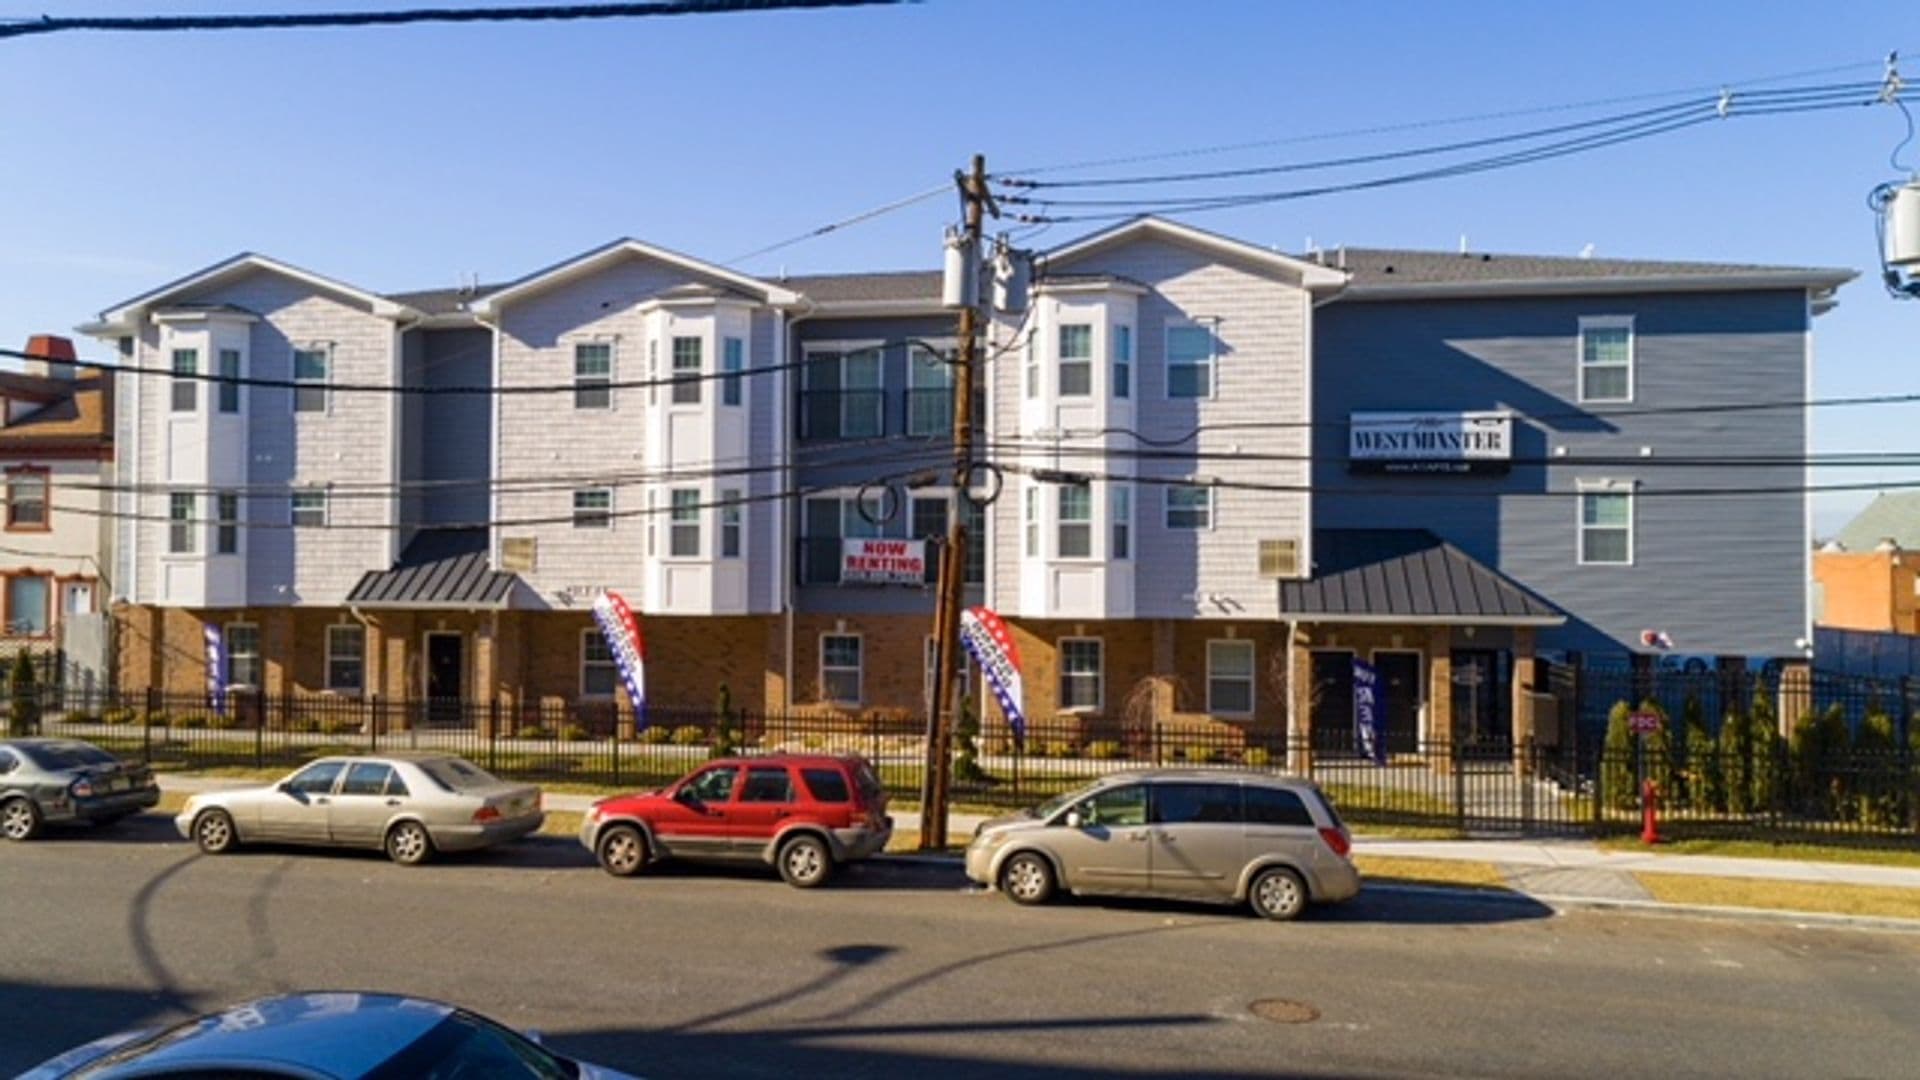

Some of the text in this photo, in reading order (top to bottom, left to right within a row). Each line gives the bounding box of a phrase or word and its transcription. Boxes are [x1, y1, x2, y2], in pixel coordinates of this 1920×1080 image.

[1354, 431, 1502, 450] WESTMINSTER
[863, 541, 907, 555] NOW
[846, 556, 922, 573] RENTING
